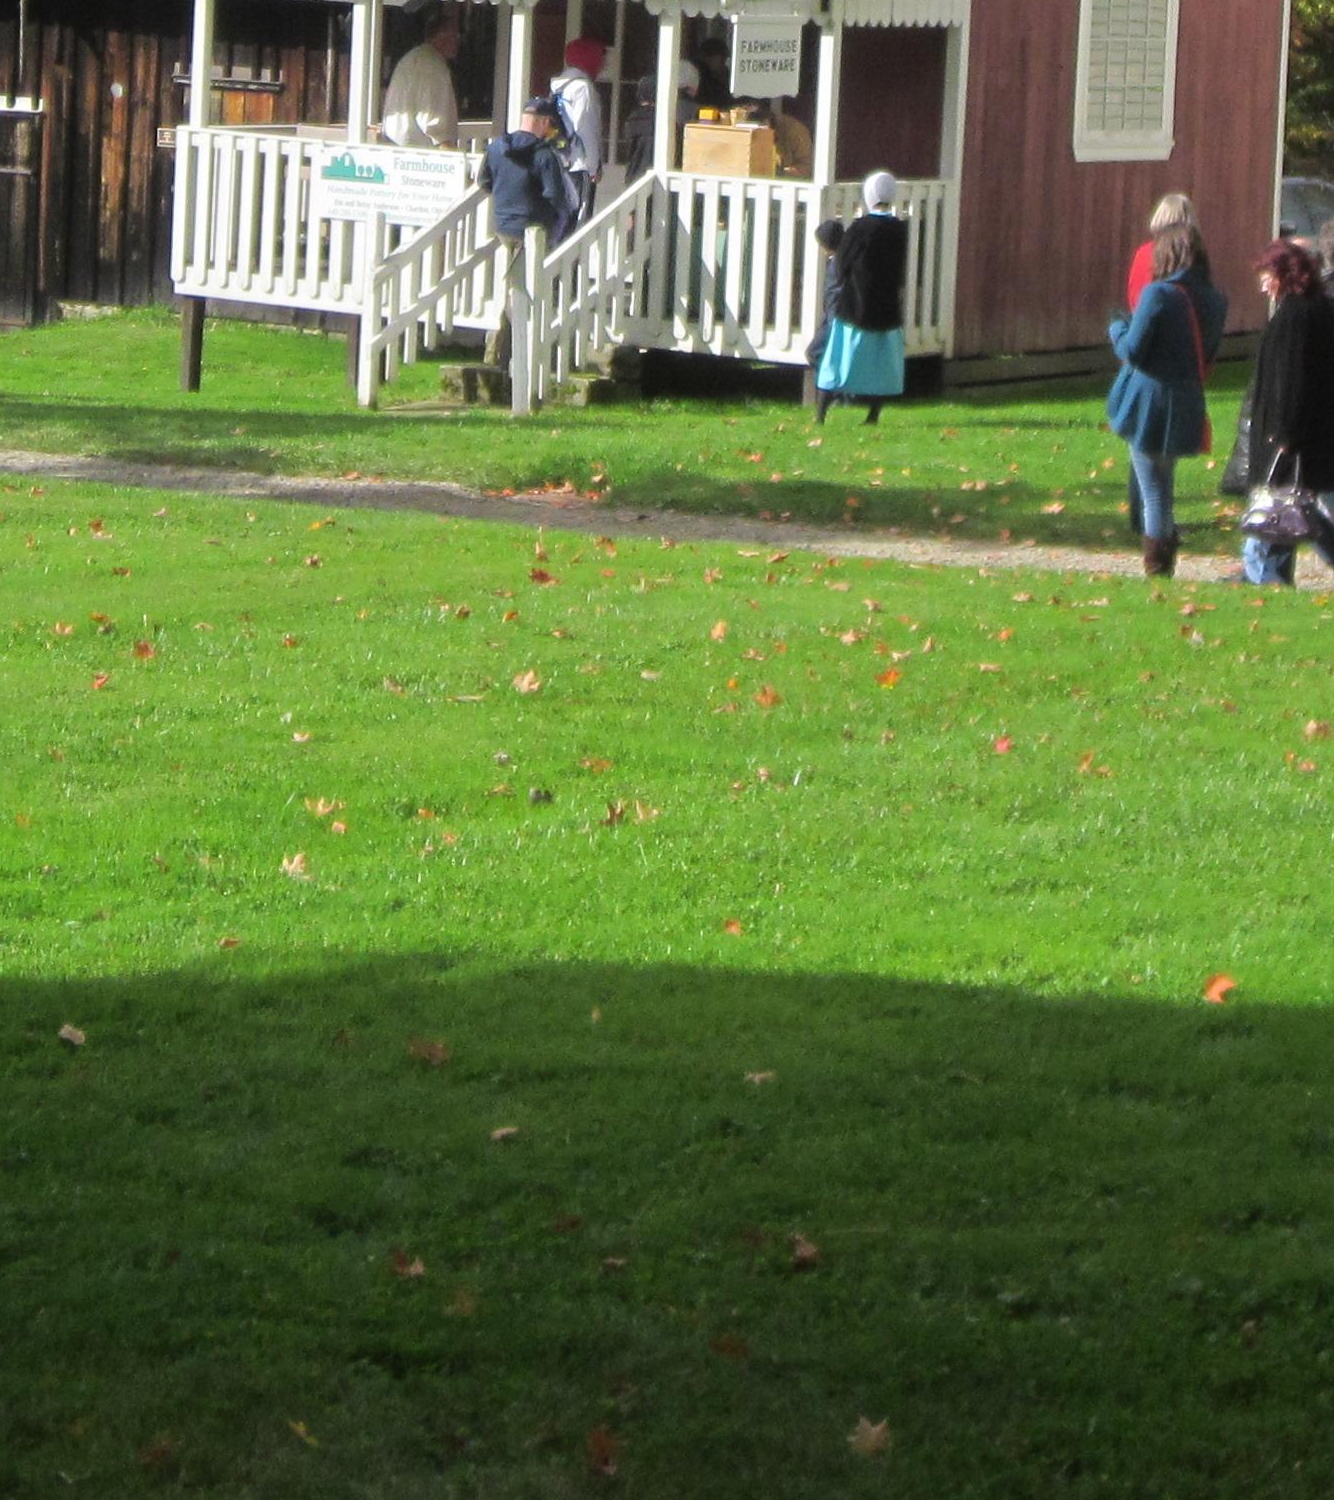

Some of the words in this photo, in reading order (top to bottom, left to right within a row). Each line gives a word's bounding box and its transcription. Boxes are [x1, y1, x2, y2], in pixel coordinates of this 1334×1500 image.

[741, 40, 798, 53] FARMHOUSE
[740, 59, 796, 73] STONEWARE
[393, 156, 455, 175] Farmhouse
[401, 174, 446, 189] Stoneware
